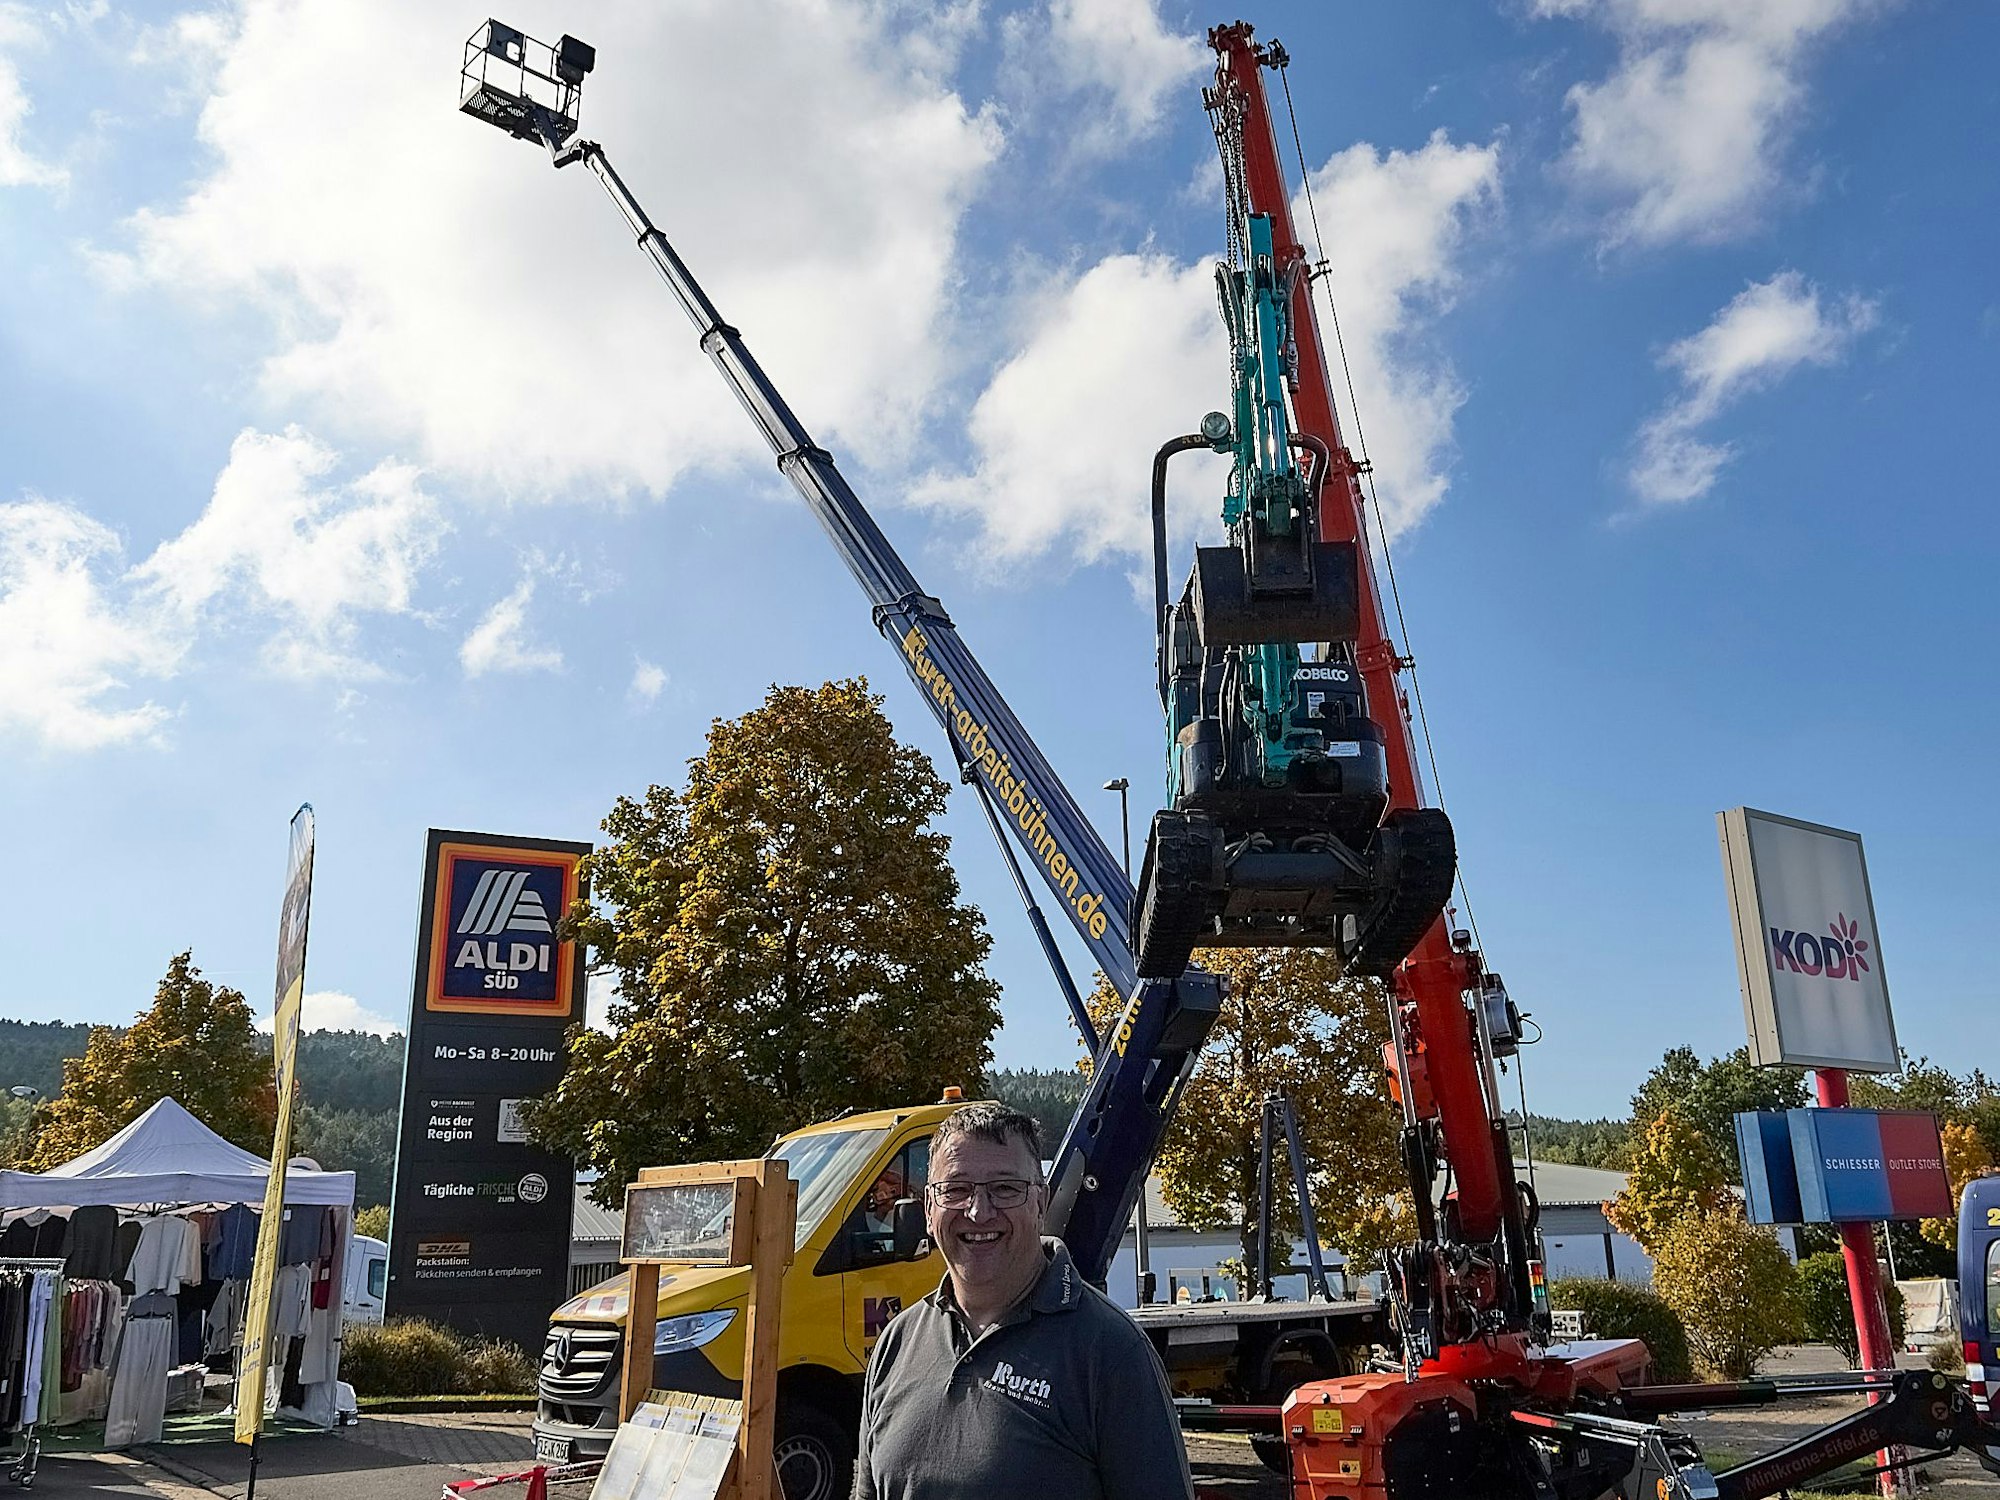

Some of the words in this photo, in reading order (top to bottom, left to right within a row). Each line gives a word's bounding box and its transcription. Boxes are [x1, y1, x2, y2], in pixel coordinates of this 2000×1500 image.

[454, 940, 550, 972] ALDI
[483, 971, 519, 989] SÜD
[530, 1048, 556, 1061] Uhr
[428, 1115, 451, 1126] Aus
[453, 1115, 474, 1126] der
[427, 1127, 473, 1142] Region
[1825, 1158, 1880, 1170] SCHIESSER
[1888, 1159, 1917, 1170] OUTLET
[1918, 1158, 1942, 1170] STORE
[423, 1182, 475, 1198] Tägliche
[477, 1183, 516, 1195] FRISCHE
[416, 1257, 470, 1266] Packstation:
[415, 1269, 455, 1279] Päckchen
[456, 1268, 487, 1278] senden
[488, 1268, 494, 1276] &
[495, 1267, 541, 1278] empfangen
[991, 1361, 1051, 1399] Kurth
[1745, 1427, 1879, 1491] Minikrane-Eifel.de
